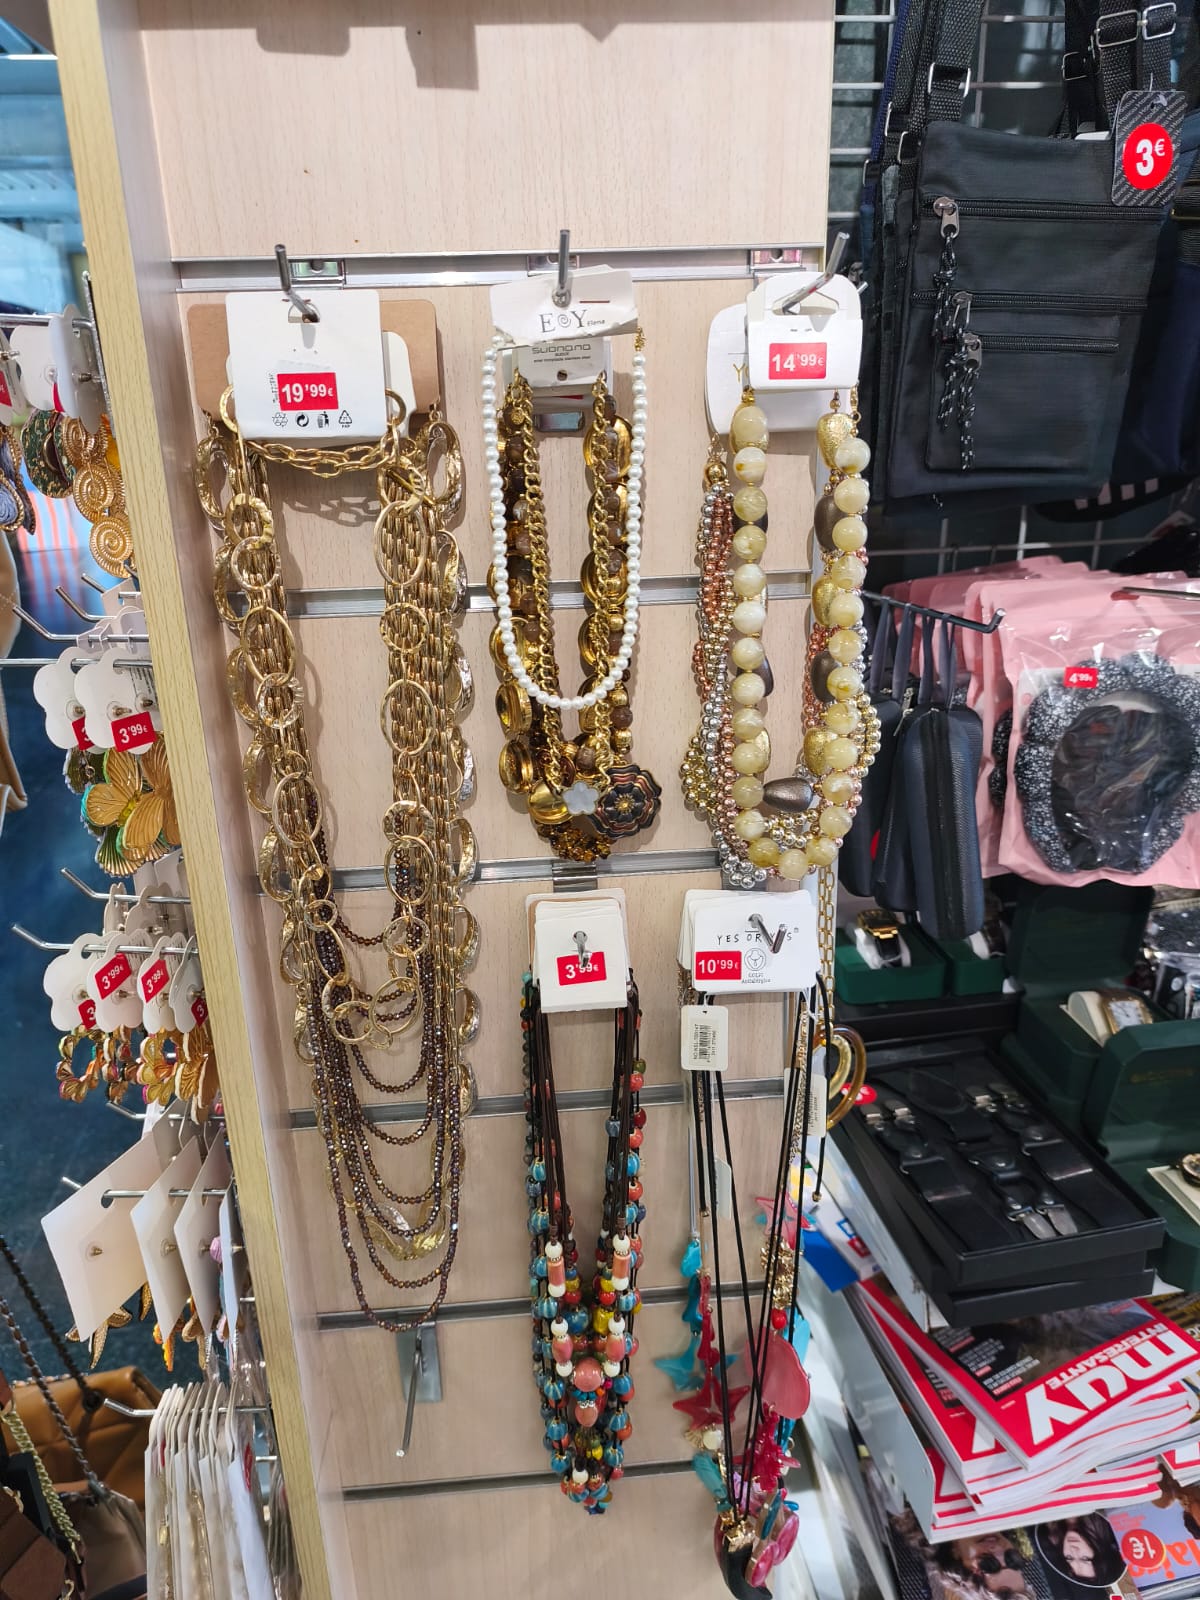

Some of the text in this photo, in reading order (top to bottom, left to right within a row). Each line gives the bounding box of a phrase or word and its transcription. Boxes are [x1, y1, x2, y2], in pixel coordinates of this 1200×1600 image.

[1136, 138, 1165, 176] 3€
[772, 353, 824, 373] 14'99€
[281, 382, 334, 404] 19'99€
[119, 723, 148, 744] 3'99€
[717, 934, 740, 945] YES
[769, 931, 792, 942] YS
[101, 963, 124, 990] 3'99€
[698, 959, 739, 974] 10'99€
[1045, 1323, 1169, 1390] INTERESANTE
[1128, 1535, 1156, 1560] 1€
